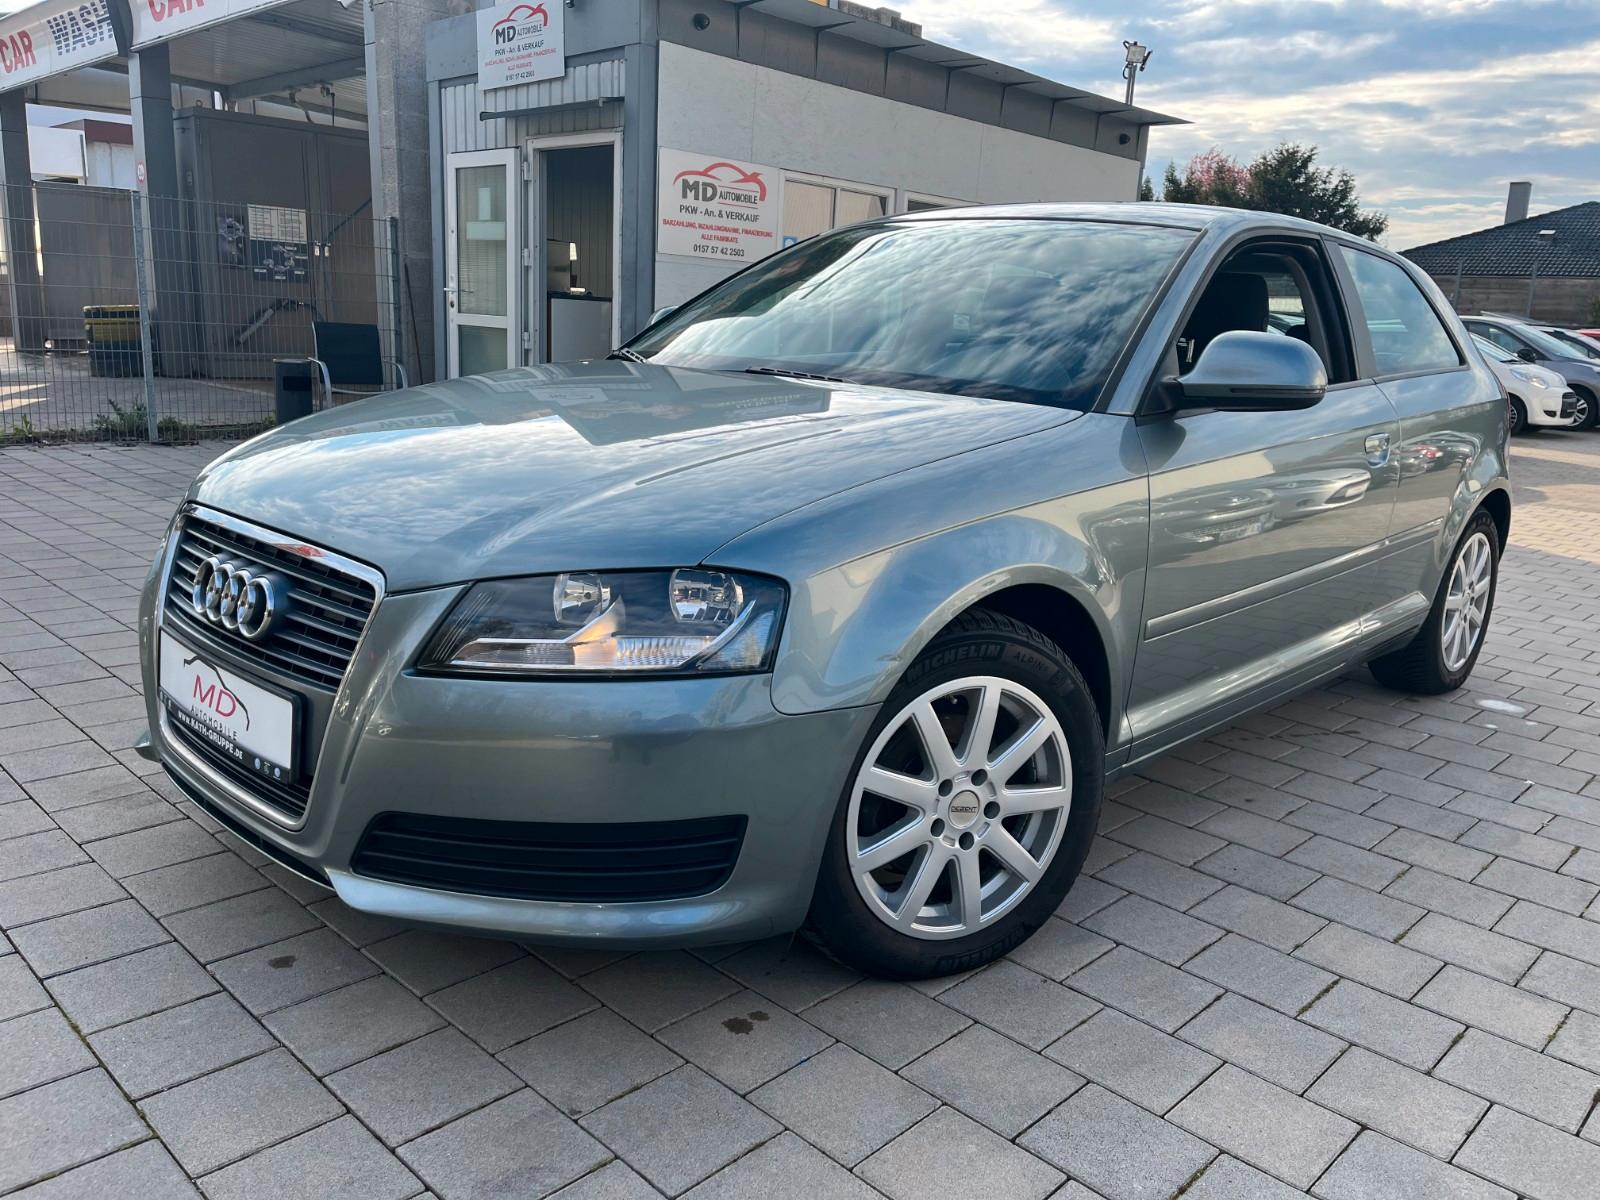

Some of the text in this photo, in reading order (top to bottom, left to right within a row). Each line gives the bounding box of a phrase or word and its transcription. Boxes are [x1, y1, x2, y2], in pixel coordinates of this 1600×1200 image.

[0, 1, 113, 73] CAR WASH
[495, 26, 516, 45] MD
[521, 40, 544, 52] VERKAUF
[682, 179, 717, 202] MD
[719, 190, 758, 204] AUTOMOBILE
[680, 204, 698, 216] PKW
[718, 209, 724, 219] &
[725, 211, 760, 223] VERKAUF
[701, 233, 712, 241] ALLE
[742, 228, 773, 238] FINANZIERUNG
[693, 243, 745, 257] 0157 57 42 2503
[907, 644, 1001, 683] MICHELIN
[193, 674, 236, 717] MD
[191, 705, 238, 741] AUTOMOBILE
